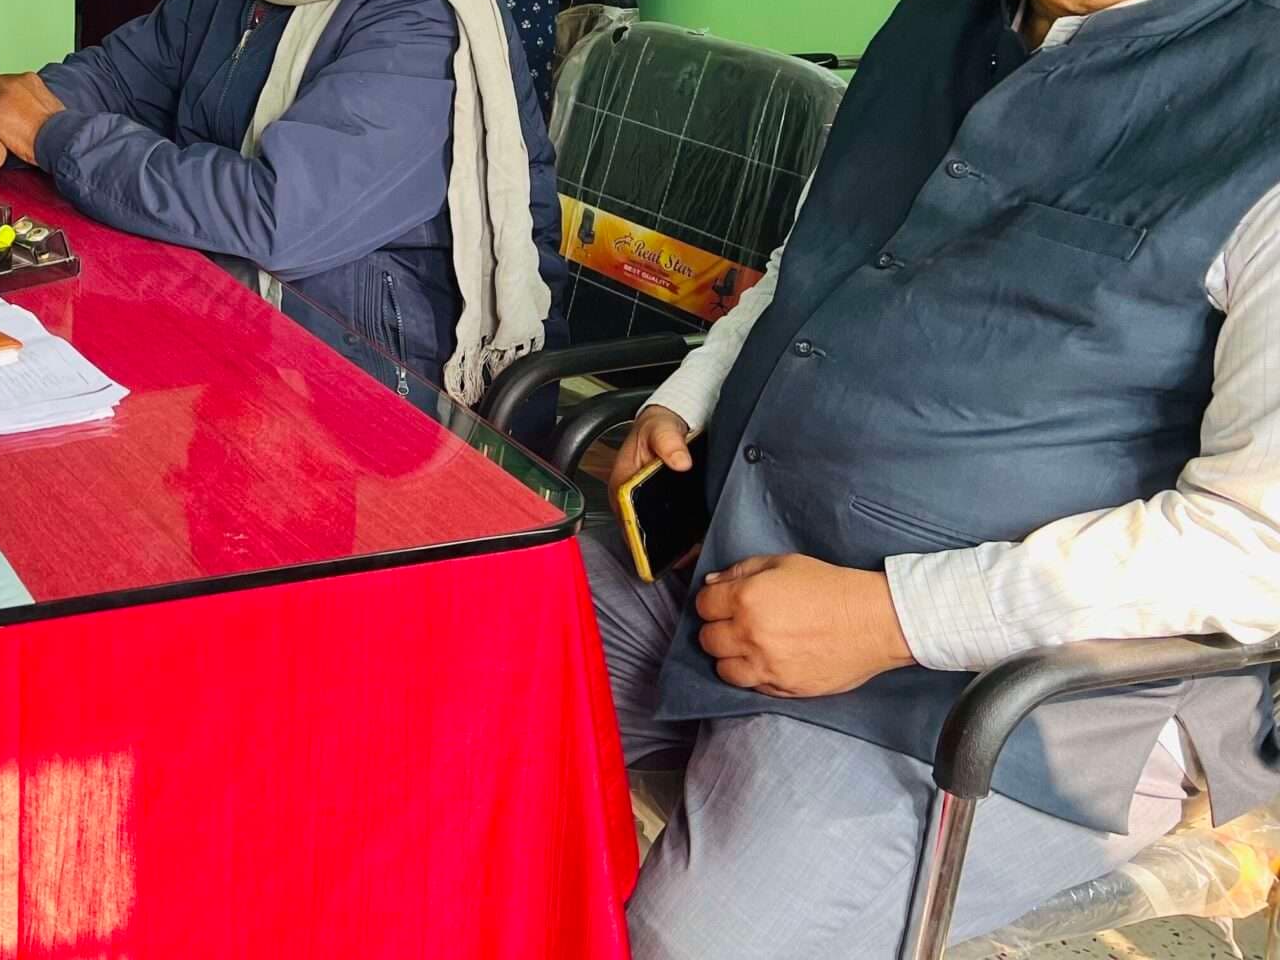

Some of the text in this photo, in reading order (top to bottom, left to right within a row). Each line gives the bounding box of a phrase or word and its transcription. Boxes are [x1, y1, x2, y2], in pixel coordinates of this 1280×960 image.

[632, 239, 693, 277] Real Star
[641, 271, 671, 287] QUALITY
